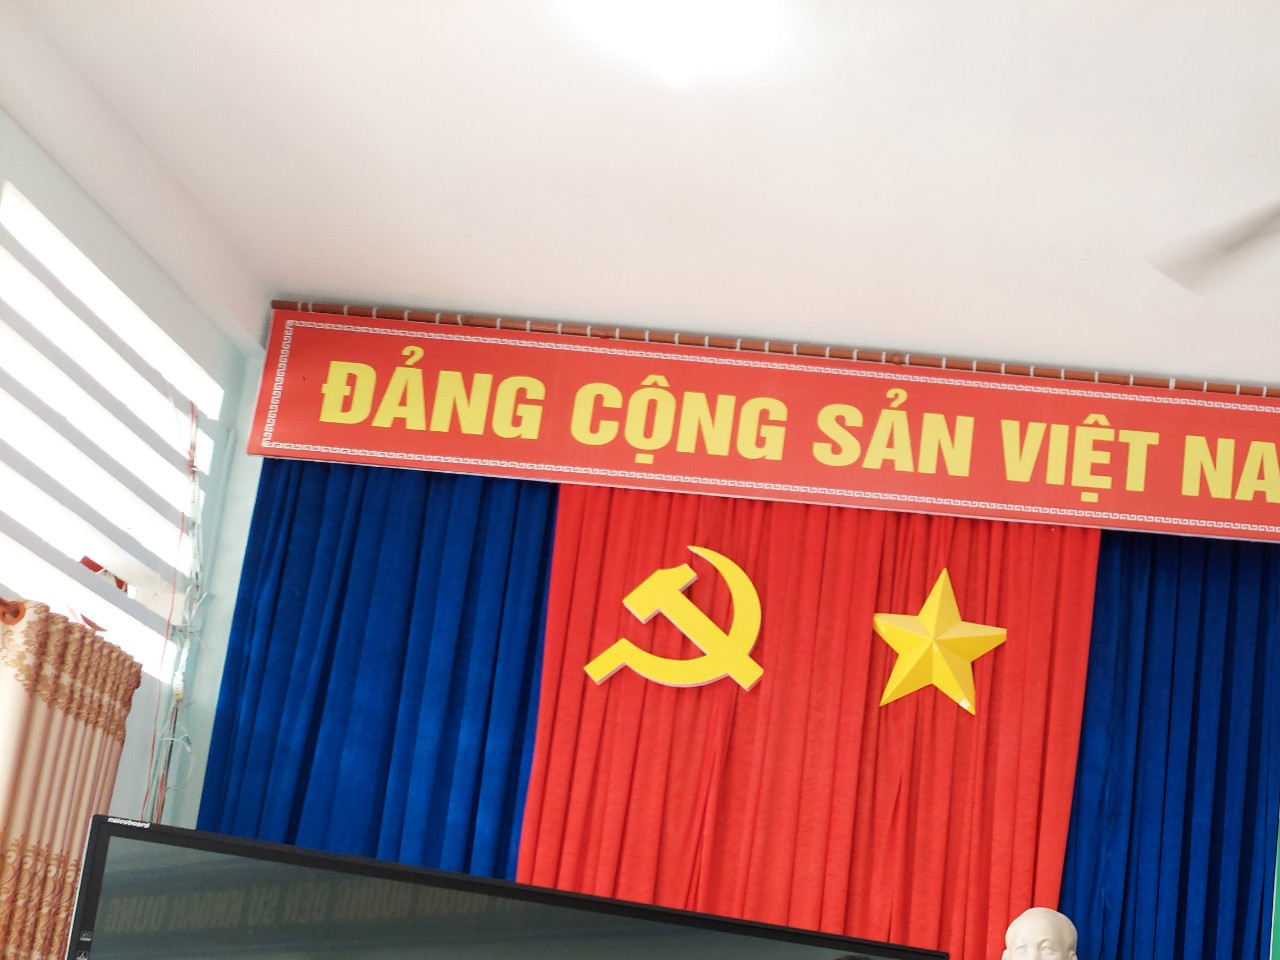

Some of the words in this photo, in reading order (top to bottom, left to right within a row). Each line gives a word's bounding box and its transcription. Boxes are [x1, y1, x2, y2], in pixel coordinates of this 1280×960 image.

[319, 346, 546, 440] ĐẢNG
[570, 375, 789, 465] CỘNG
[812, 388, 975, 478] SẢN
[1001, 413, 1160, 503] VIỆT
